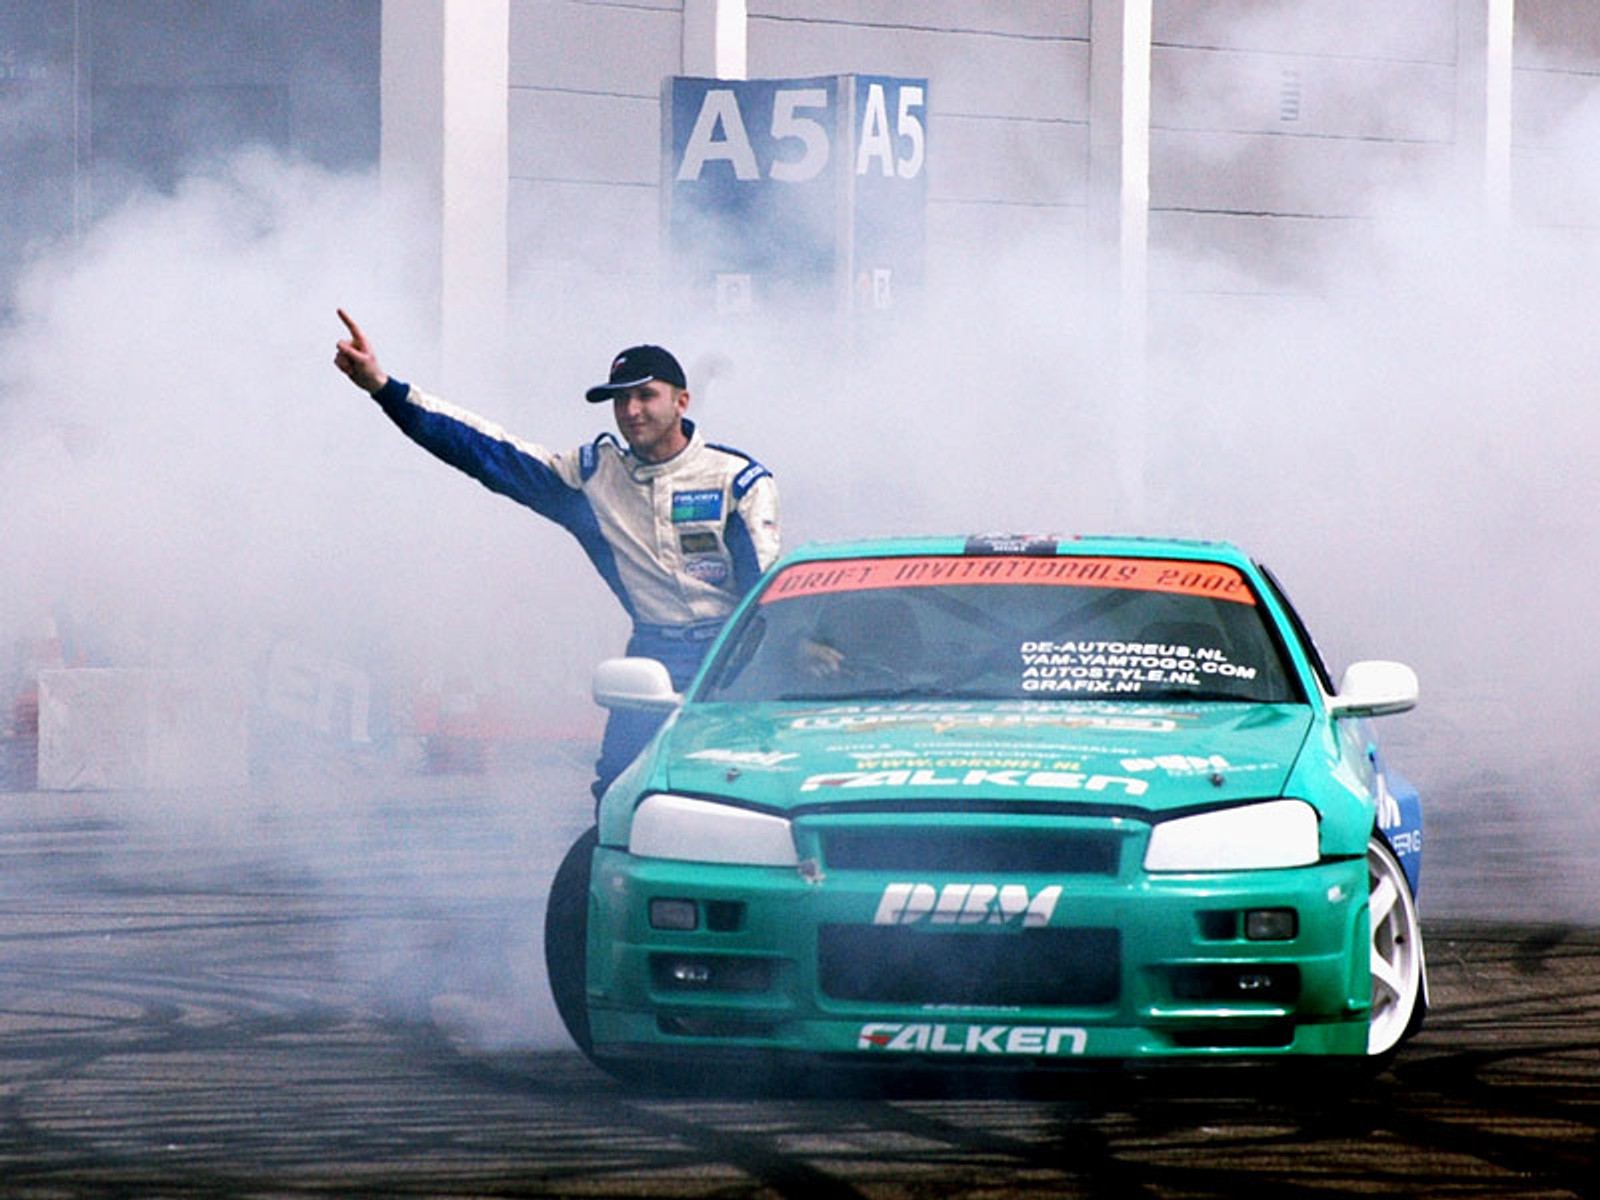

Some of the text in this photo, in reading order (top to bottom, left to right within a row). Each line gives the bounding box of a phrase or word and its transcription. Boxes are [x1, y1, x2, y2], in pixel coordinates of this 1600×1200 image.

[677, 89, 829, 182] A5
[857, 84, 923, 179] A5
[781, 566, 873, 592] DRIFT
[894, 560, 1137, 583] INVITATIONALS
[1021, 654, 1257, 680] YAM-YAMTOGO.COM
[1022, 666, 1201, 685] AUTOSTYLE.NL
[801, 770, 1148, 796] FALKEN
[858, 1022, 1088, 1055] FALKEN
